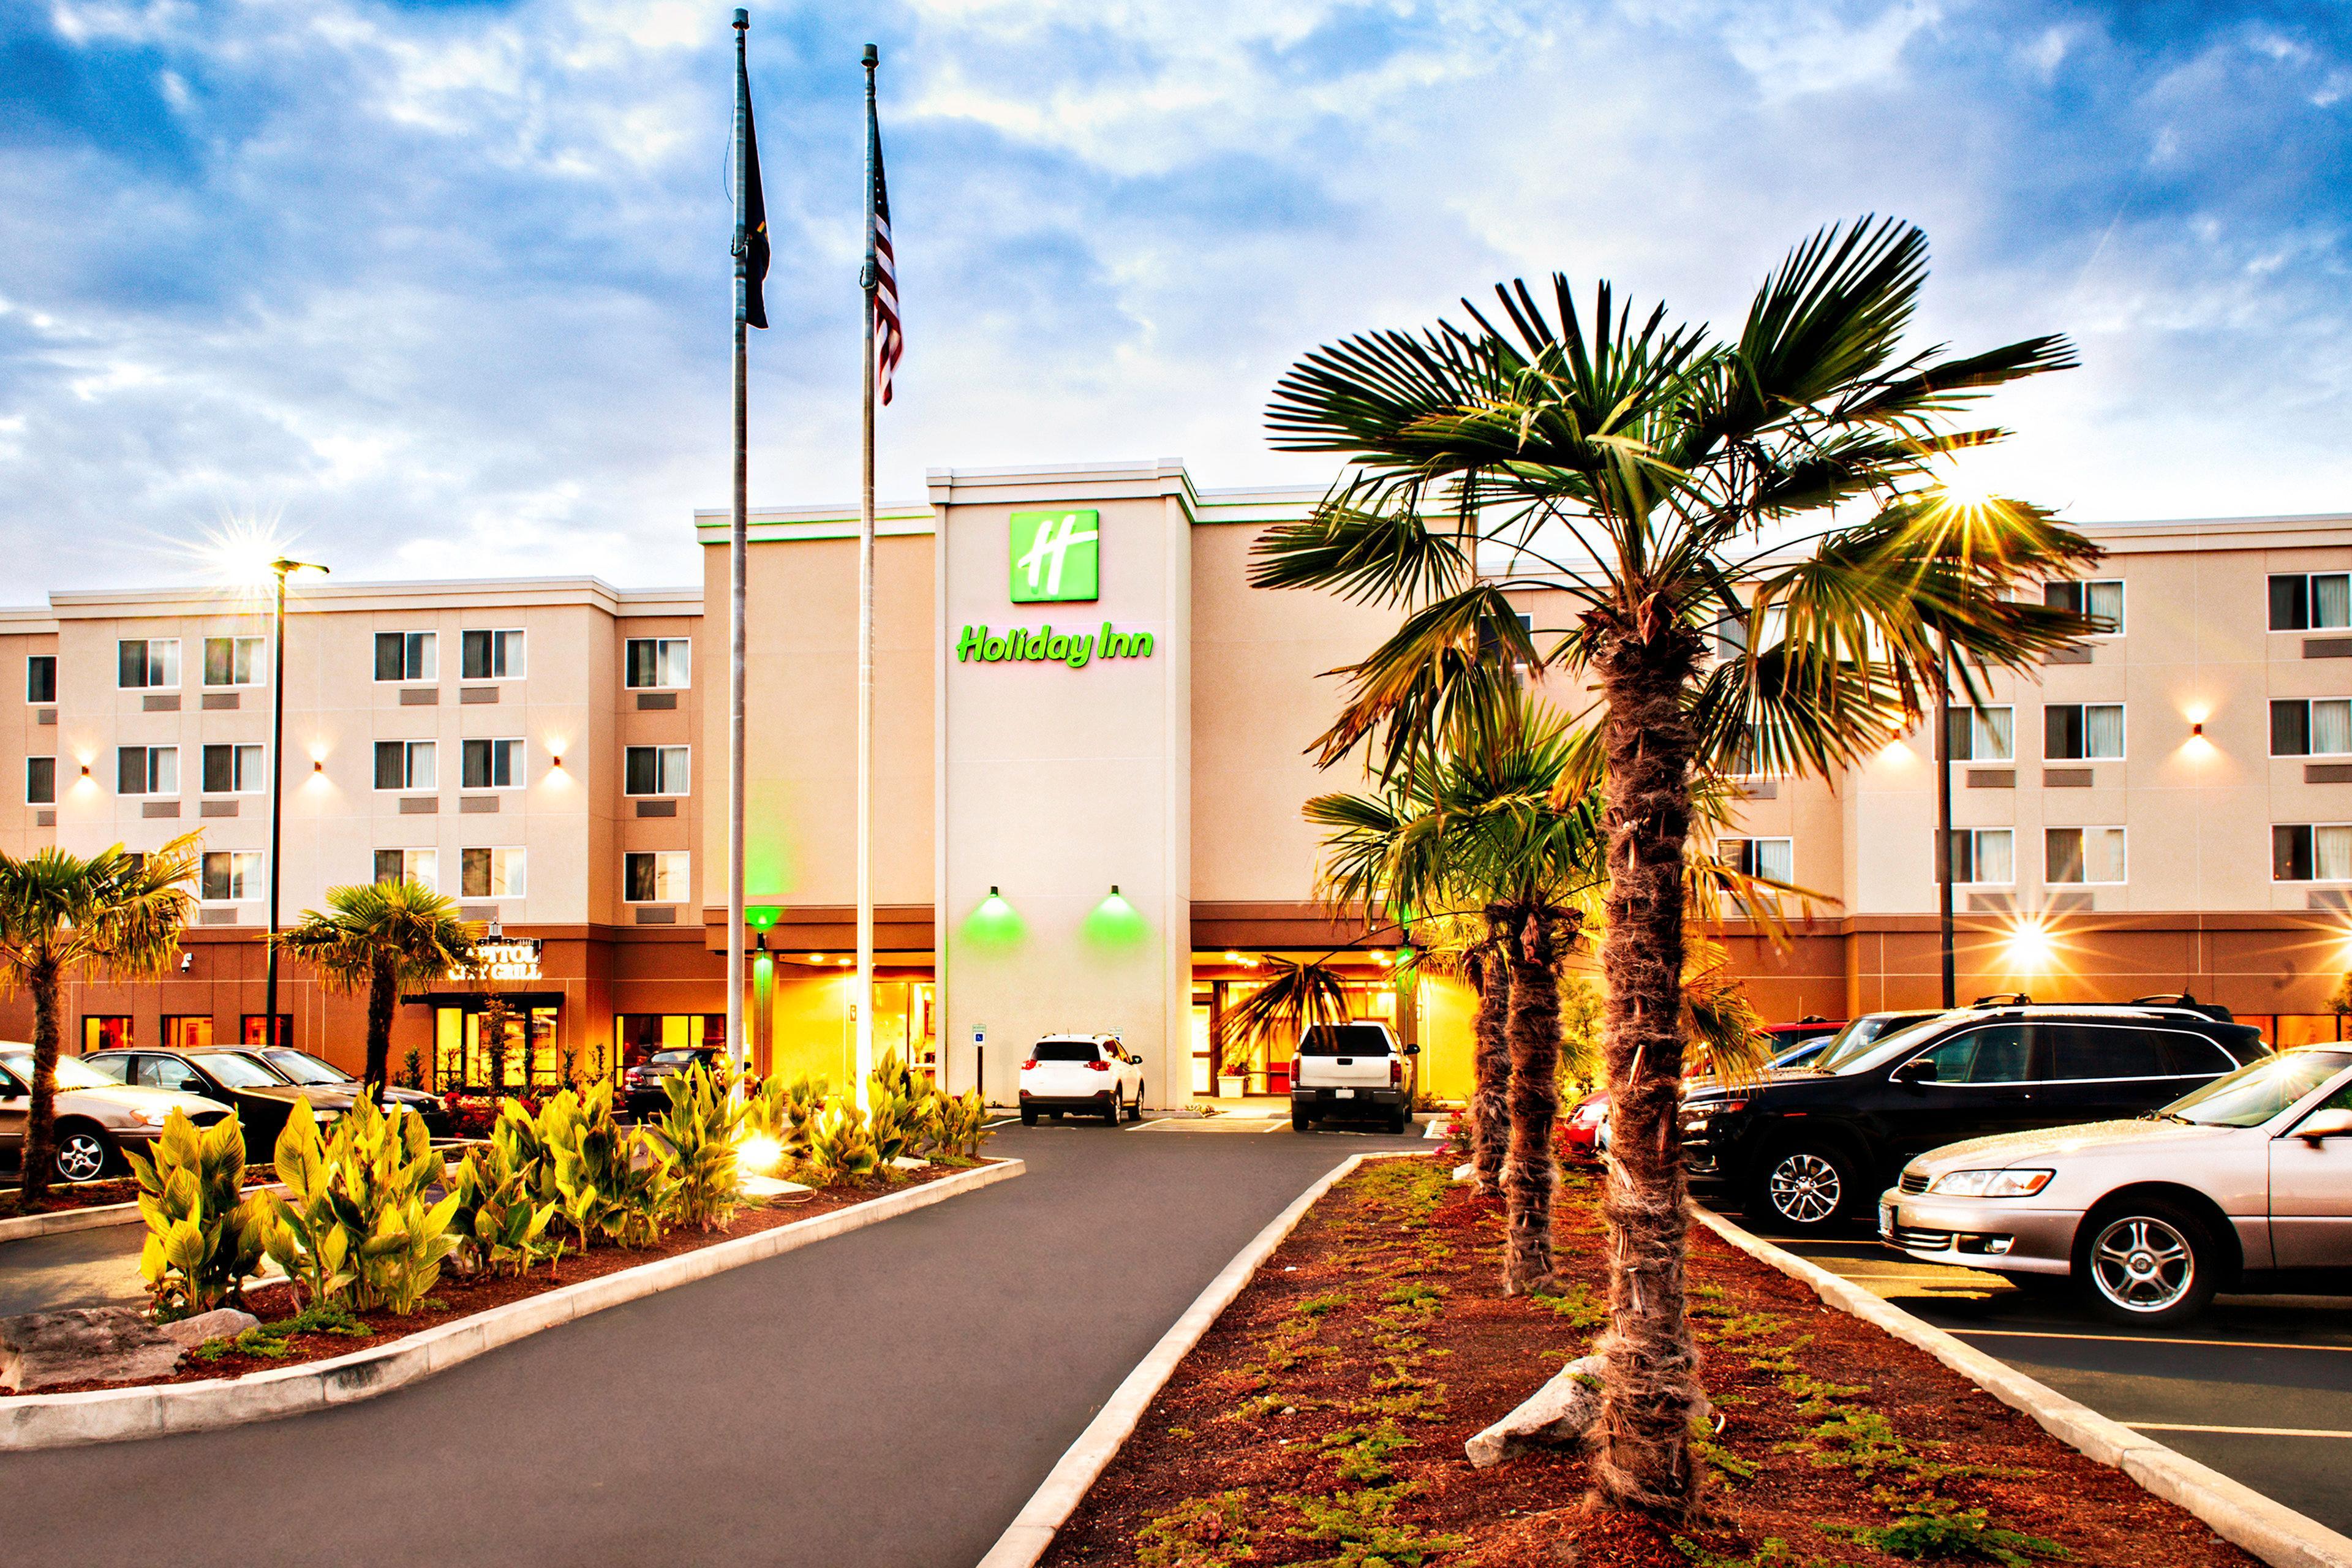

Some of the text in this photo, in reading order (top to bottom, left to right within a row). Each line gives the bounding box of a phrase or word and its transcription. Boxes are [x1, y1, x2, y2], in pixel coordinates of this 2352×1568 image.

[1017, 514, 1098, 595] H
[956, 622, 1154, 668] Holiday Inn
[491, 963, 542, 980] GRILL
